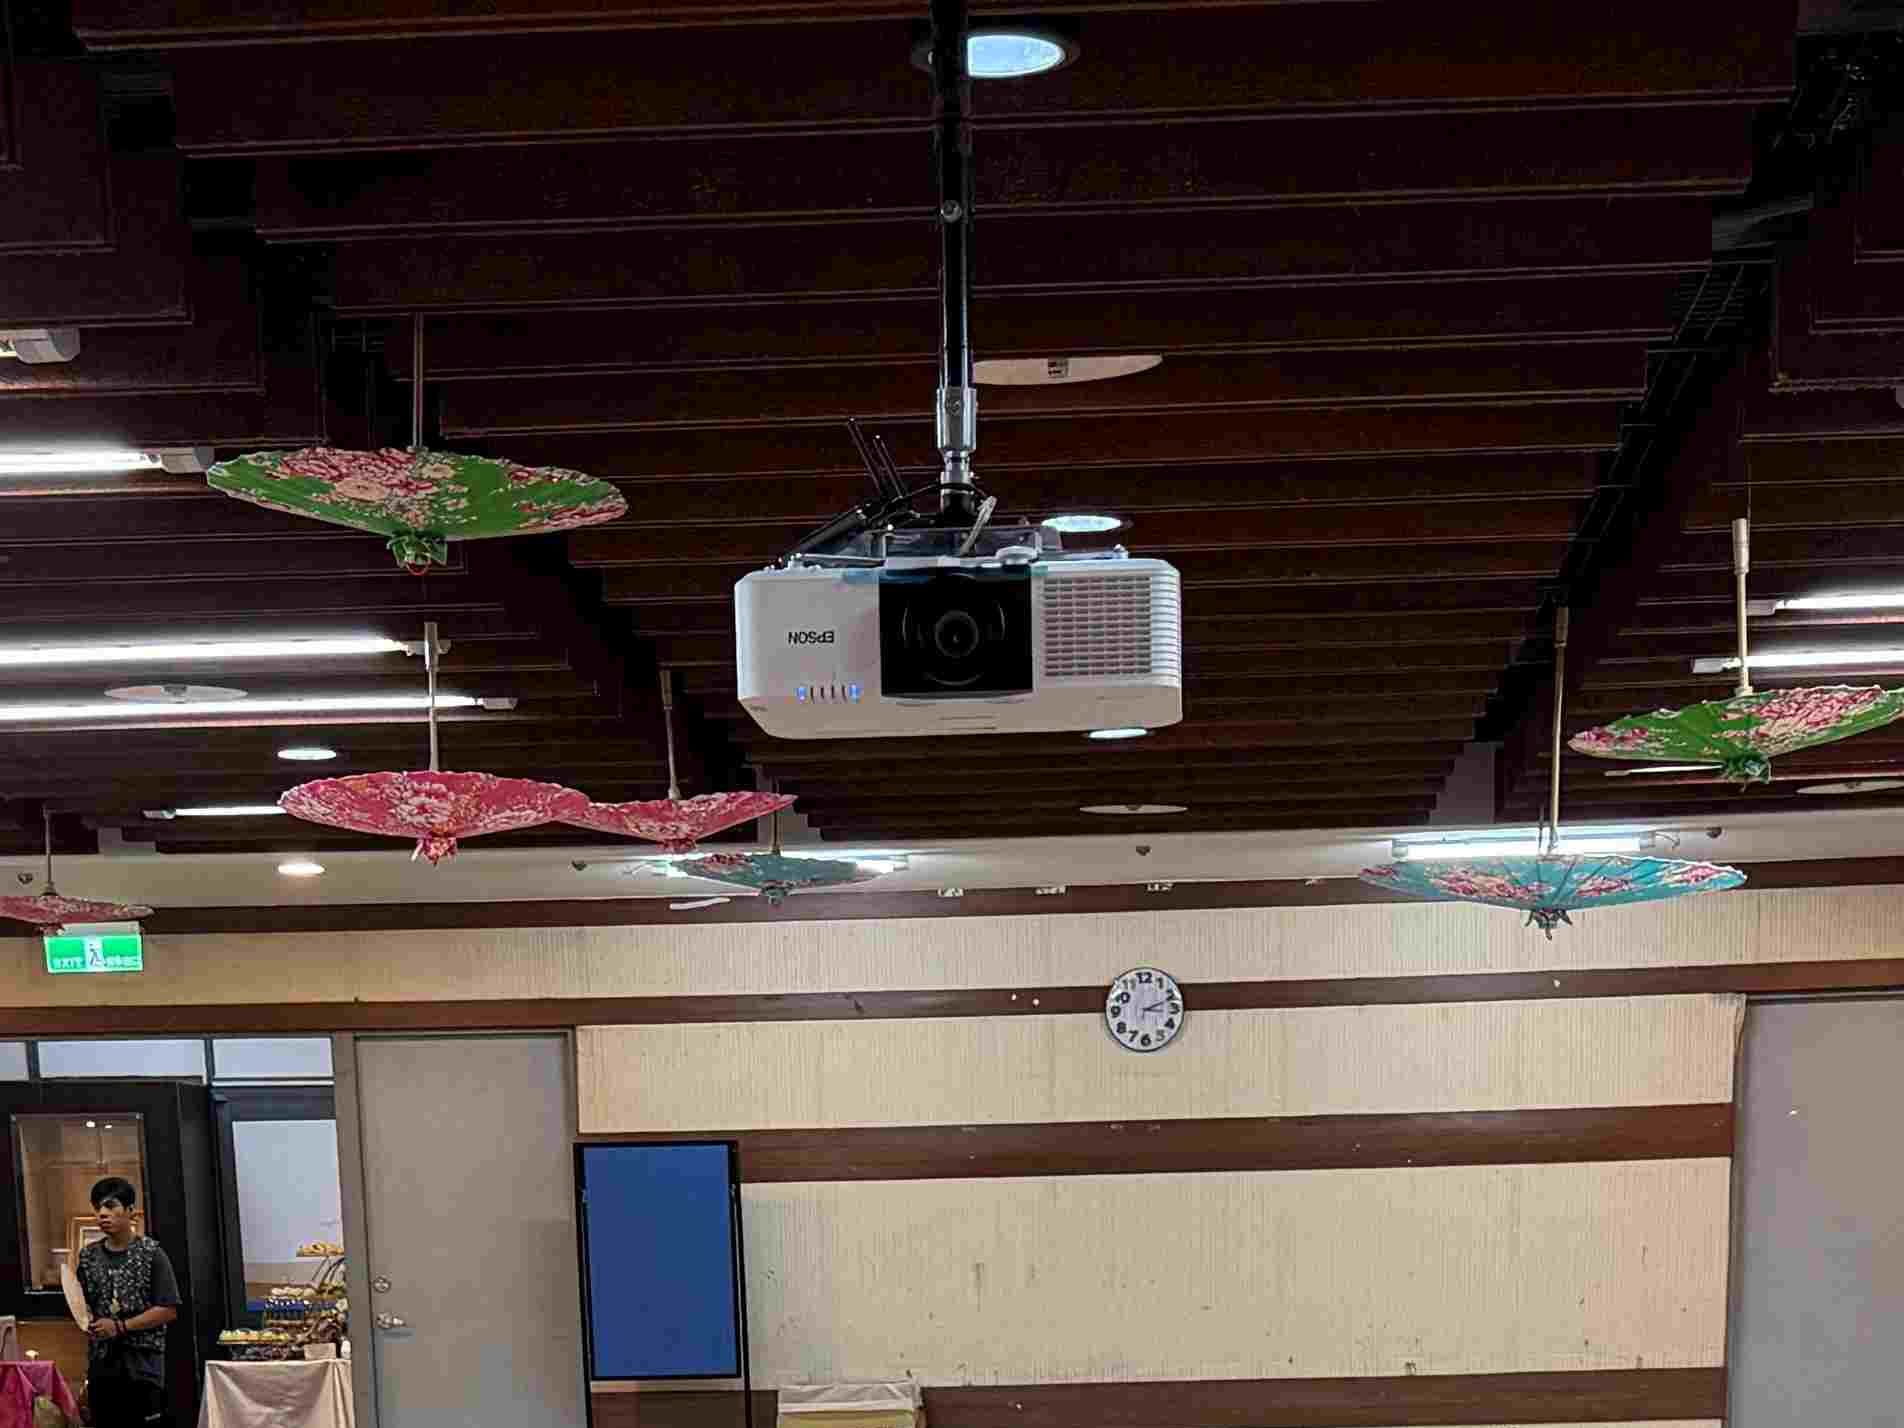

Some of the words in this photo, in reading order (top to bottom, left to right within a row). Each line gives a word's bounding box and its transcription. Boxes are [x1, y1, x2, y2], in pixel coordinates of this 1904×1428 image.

[788, 630, 835, 645] EPSON
[1136, 971, 1153, 985] 12
[1156, 977, 1164, 989] 1
[1122, 979, 1136, 991] 11
[1110, 1005, 1122, 1018] 9
[1168, 1002, 1180, 1015] 3
[1116, 1021, 1127, 1034] 8
[1164, 1017, 1175, 1030] 4
[1128, 1029, 1139, 1043] 7
[1140, 1033, 1152, 1047] 6
[1155, 1029, 1166, 1042] 5
